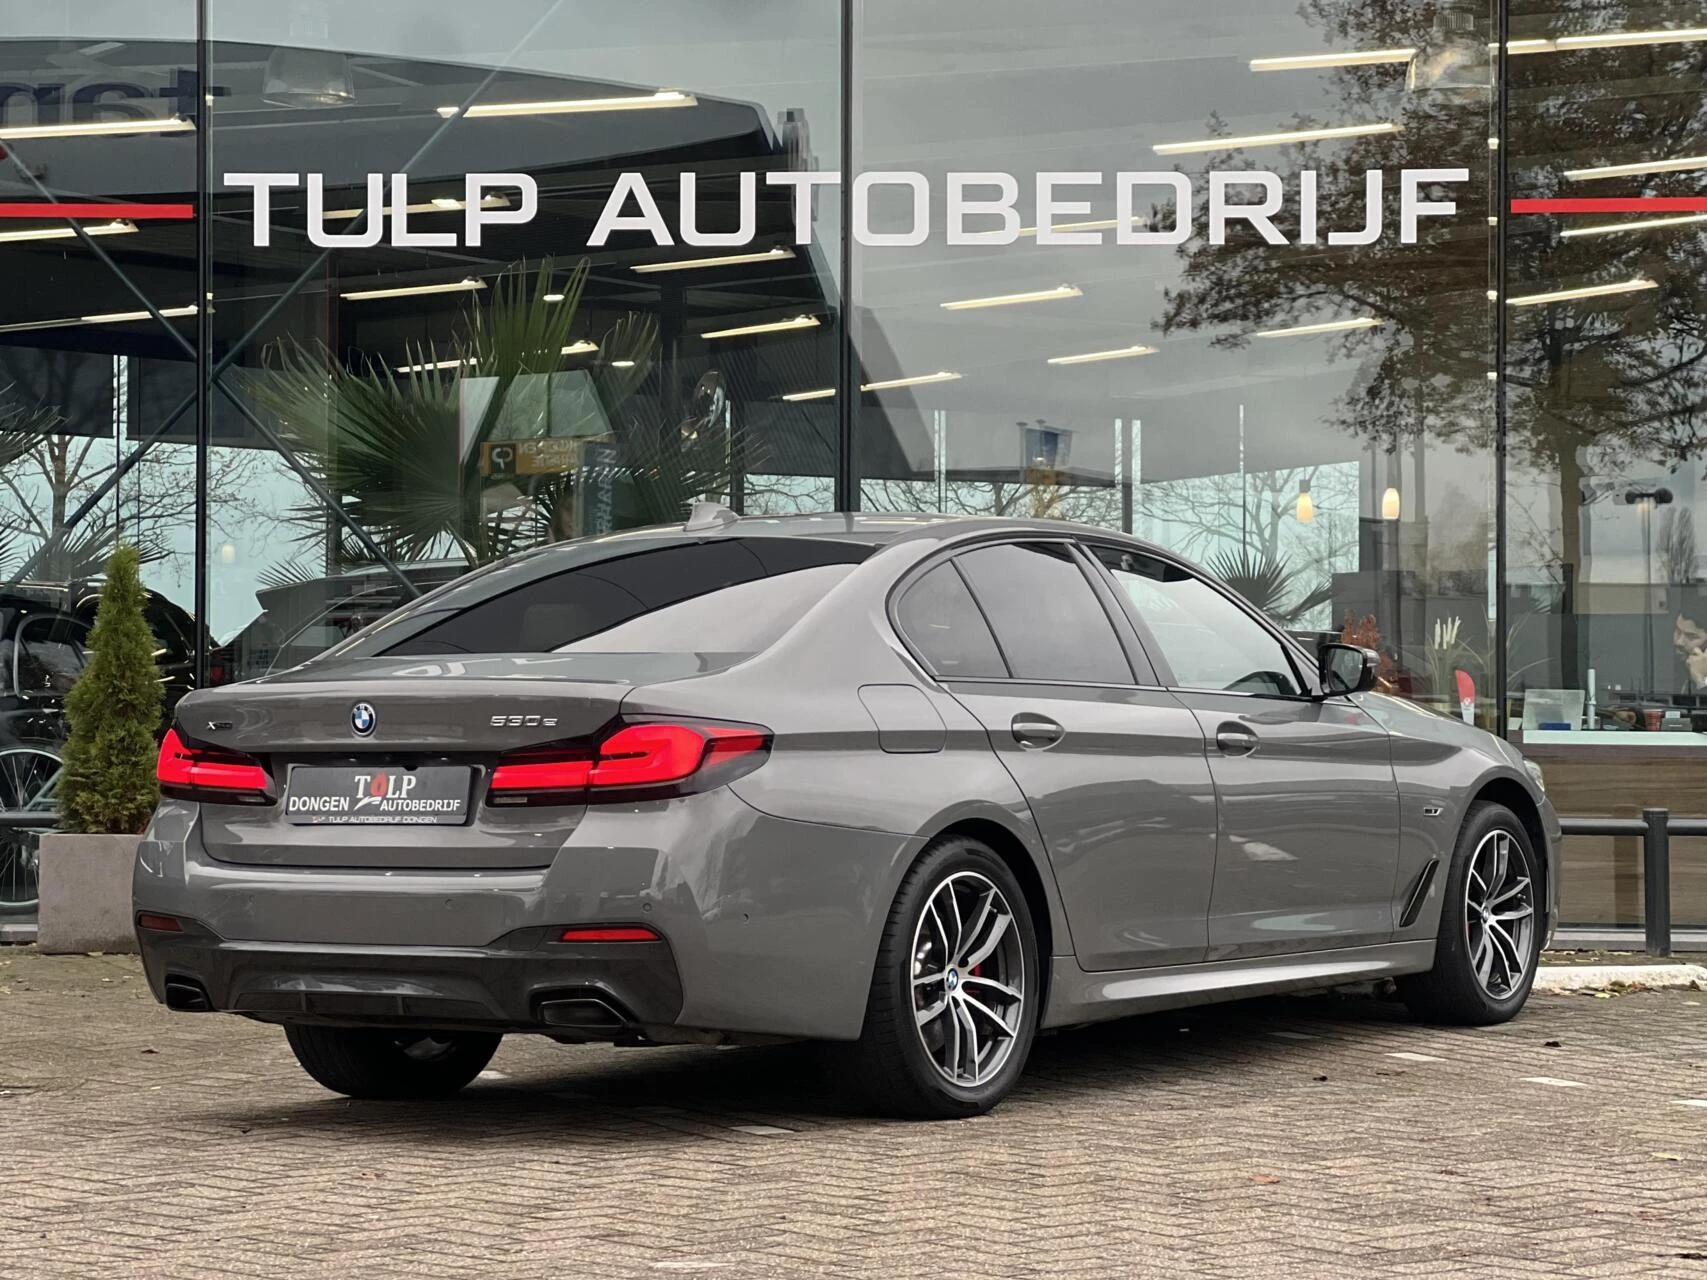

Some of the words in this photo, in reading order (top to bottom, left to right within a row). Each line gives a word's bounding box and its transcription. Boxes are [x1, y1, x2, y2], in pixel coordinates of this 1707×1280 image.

[223, 173, 538, 248] TULP
[587, 168, 1469, 247] AUTOBEDRIJF
[490, 715, 558, 726] 530e
[289, 796, 350, 812] DONGEN
[379, 799, 461, 812] AUTOBEDRIJF
[403, 816, 438, 824] DONGEN
